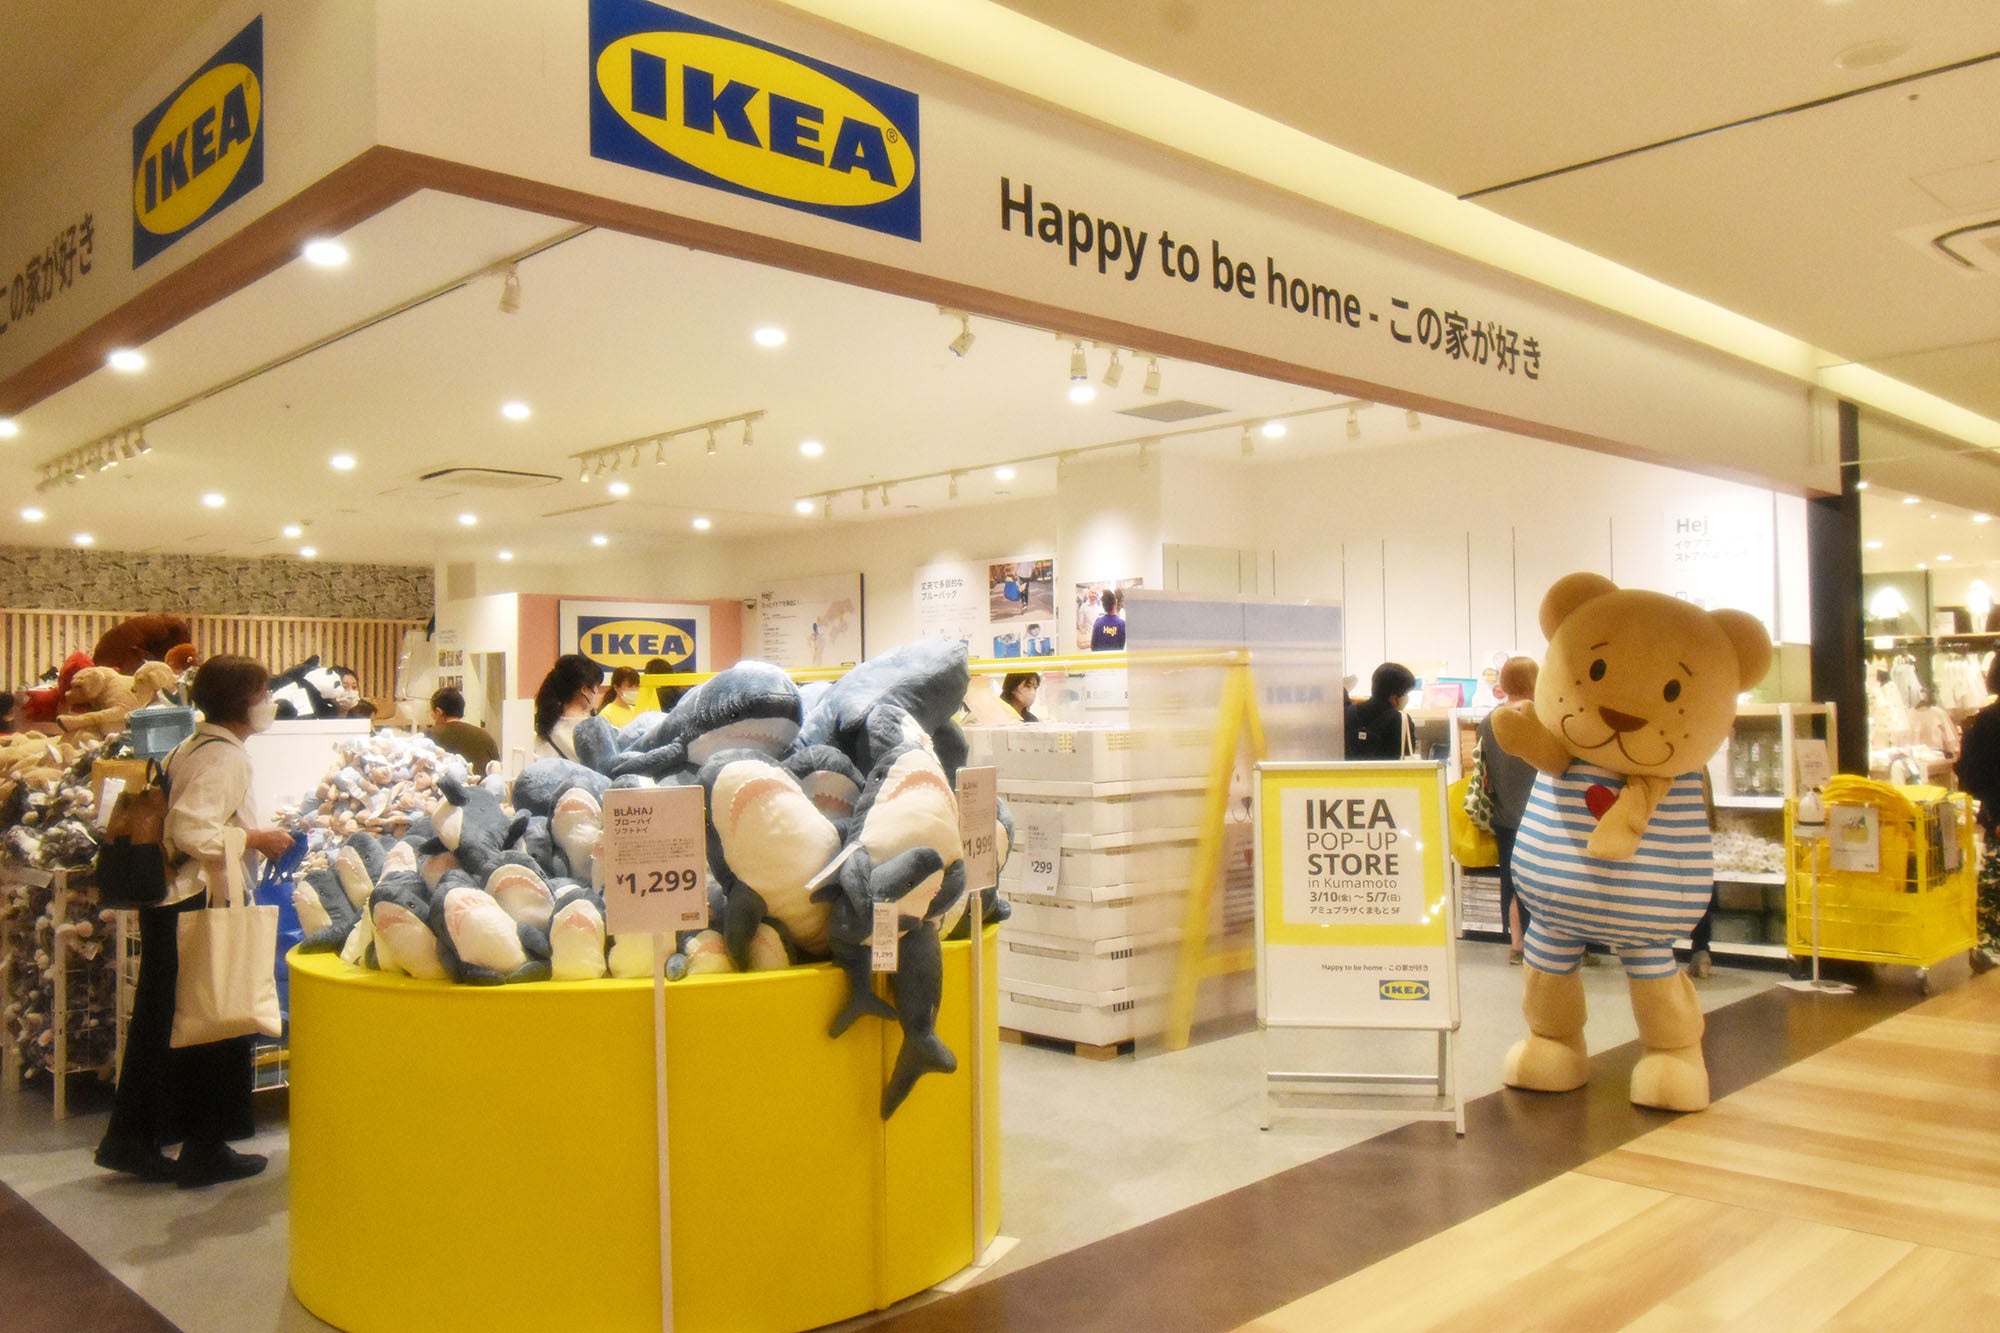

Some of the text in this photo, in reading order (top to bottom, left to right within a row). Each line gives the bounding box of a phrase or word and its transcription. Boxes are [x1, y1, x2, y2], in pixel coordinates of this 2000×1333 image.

[631, 48, 897, 187] IKEA
[145, 82, 250, 213] IKEA
[1001, 176, 1147, 281] Happy
[1158, 231, 1199, 282] to
[1212, 239, 1256, 299] be
[1267, 256, 1360, 328] home
[1391, 297, 1541, 379] この家が好き
[591, 633, 687, 655] IKEA
[614, 806, 653, 817] BLÅHAJ
[1306, 799, 1396, 829] IKEA
[1307, 832, 1398, 850] POP-UP
[1308, 853, 1399, 875] STORE
[616, 869, 697, 897] ¥1,299
[1308, 878, 1397, 888] in Kumamoto
[1310, 906, 1389, 914] アミュプラザくまもと
[1384, 986, 1425, 994] IKEA
